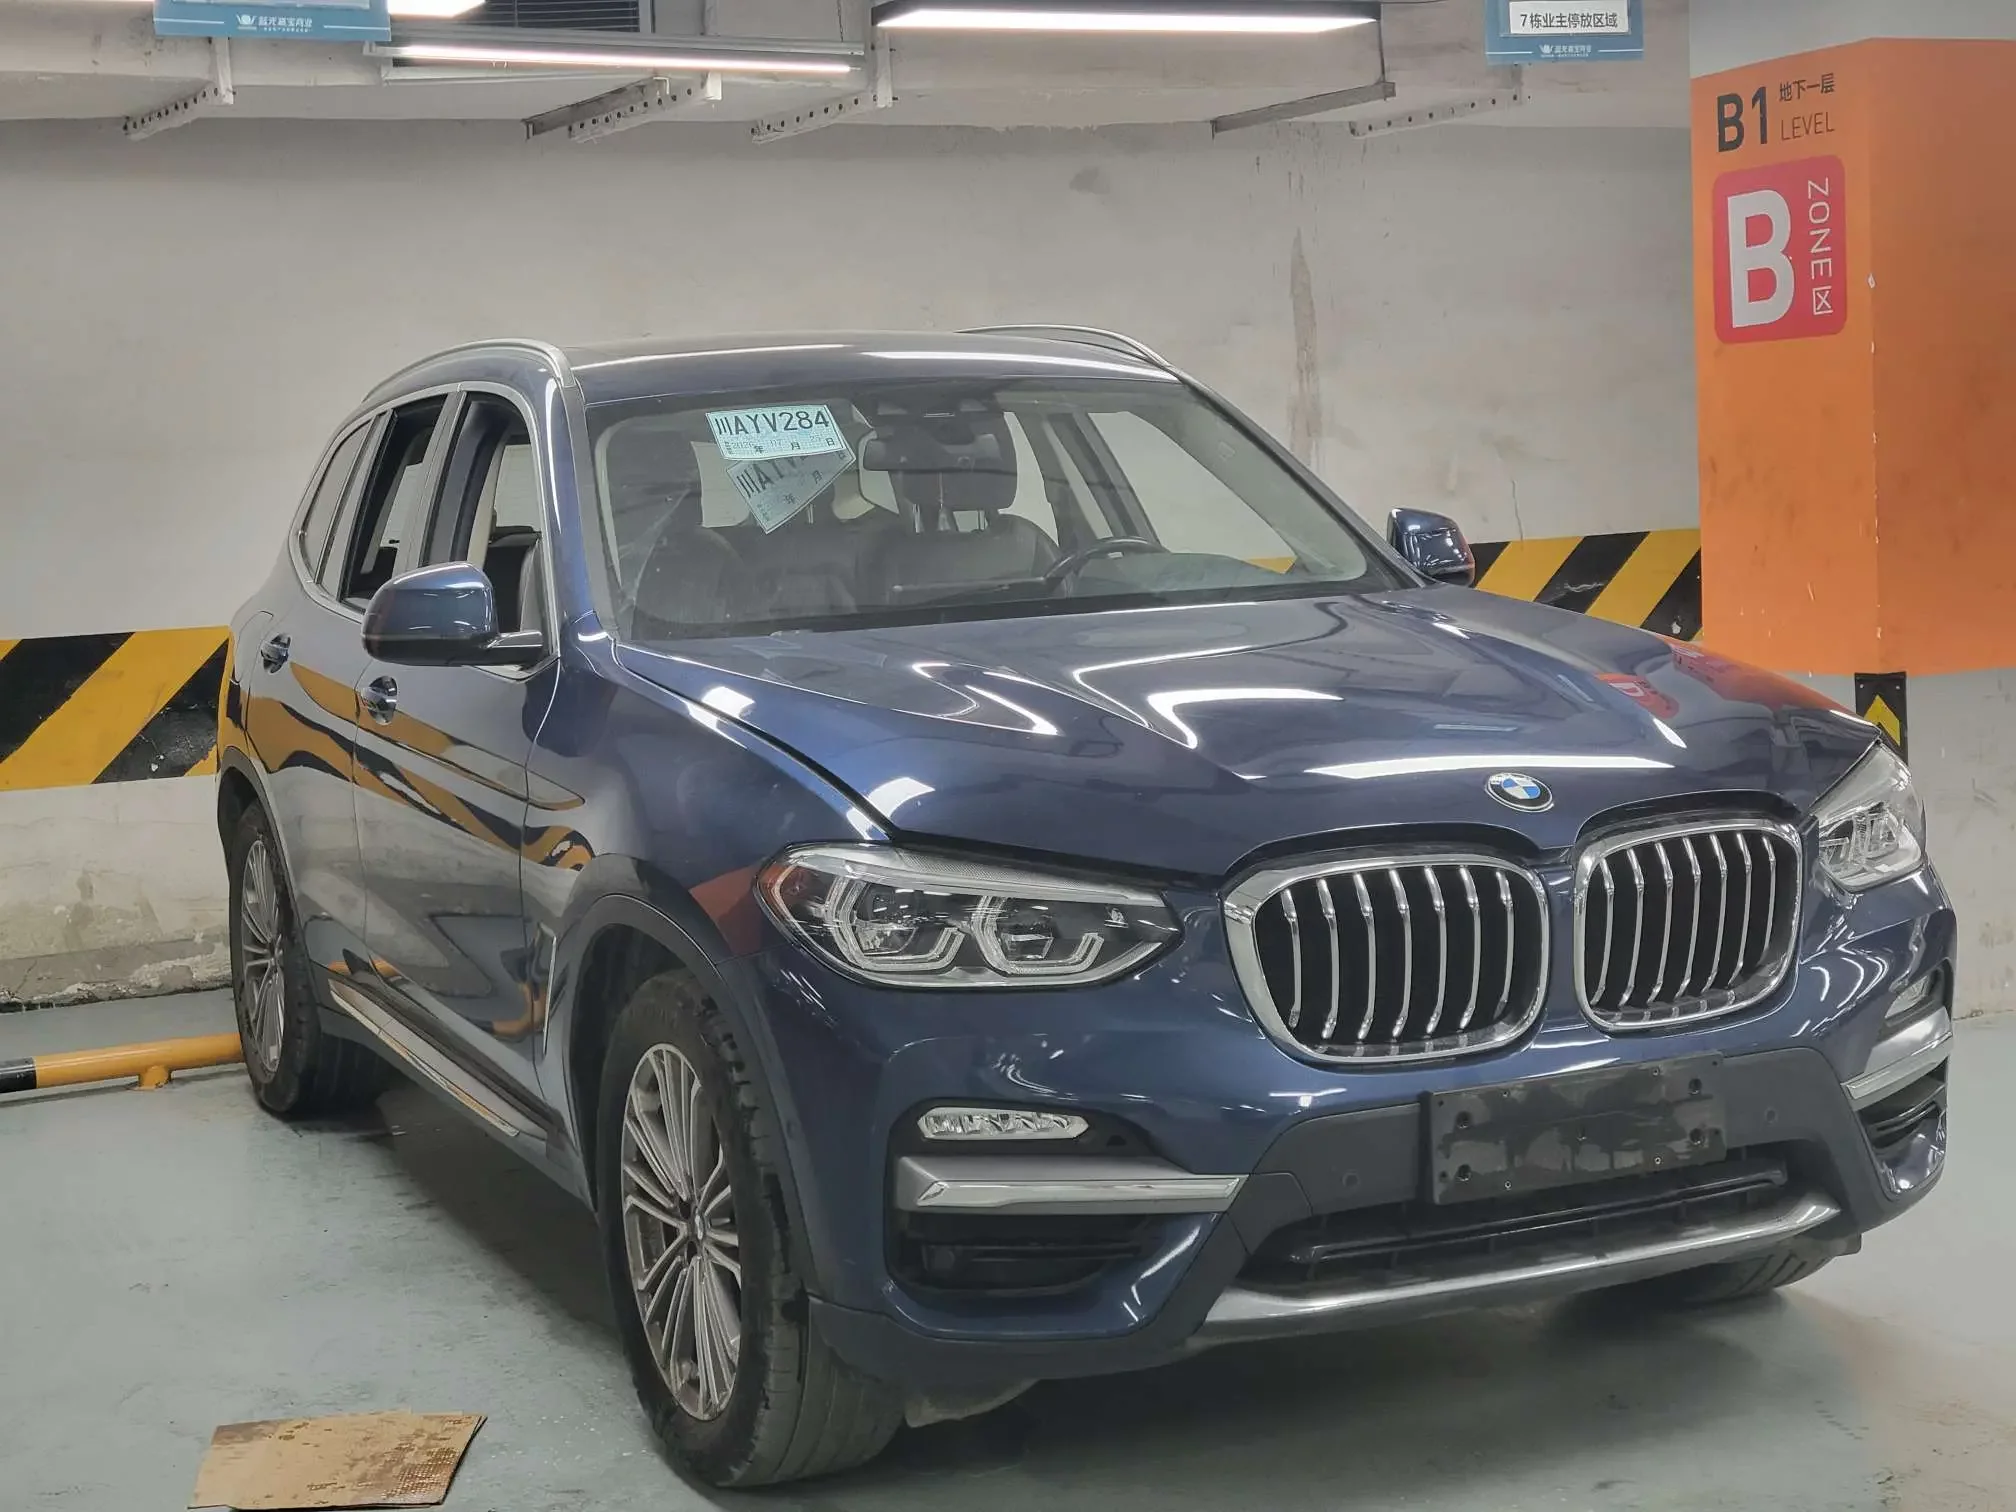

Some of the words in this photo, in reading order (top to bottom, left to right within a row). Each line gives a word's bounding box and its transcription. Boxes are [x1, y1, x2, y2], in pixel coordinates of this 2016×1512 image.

[1519, 12, 1619, 29] 7栋业主停放区域
[1778, 72, 1836, 102] 地下一层
[1716, 86, 1769, 153] B1
[1780, 111, 1835, 141] LEVEL
[1807, 177, 1833, 281] ZONE
[1727, 189, 1795, 329] B
[714, 410, 830, 436] 川AYV284
